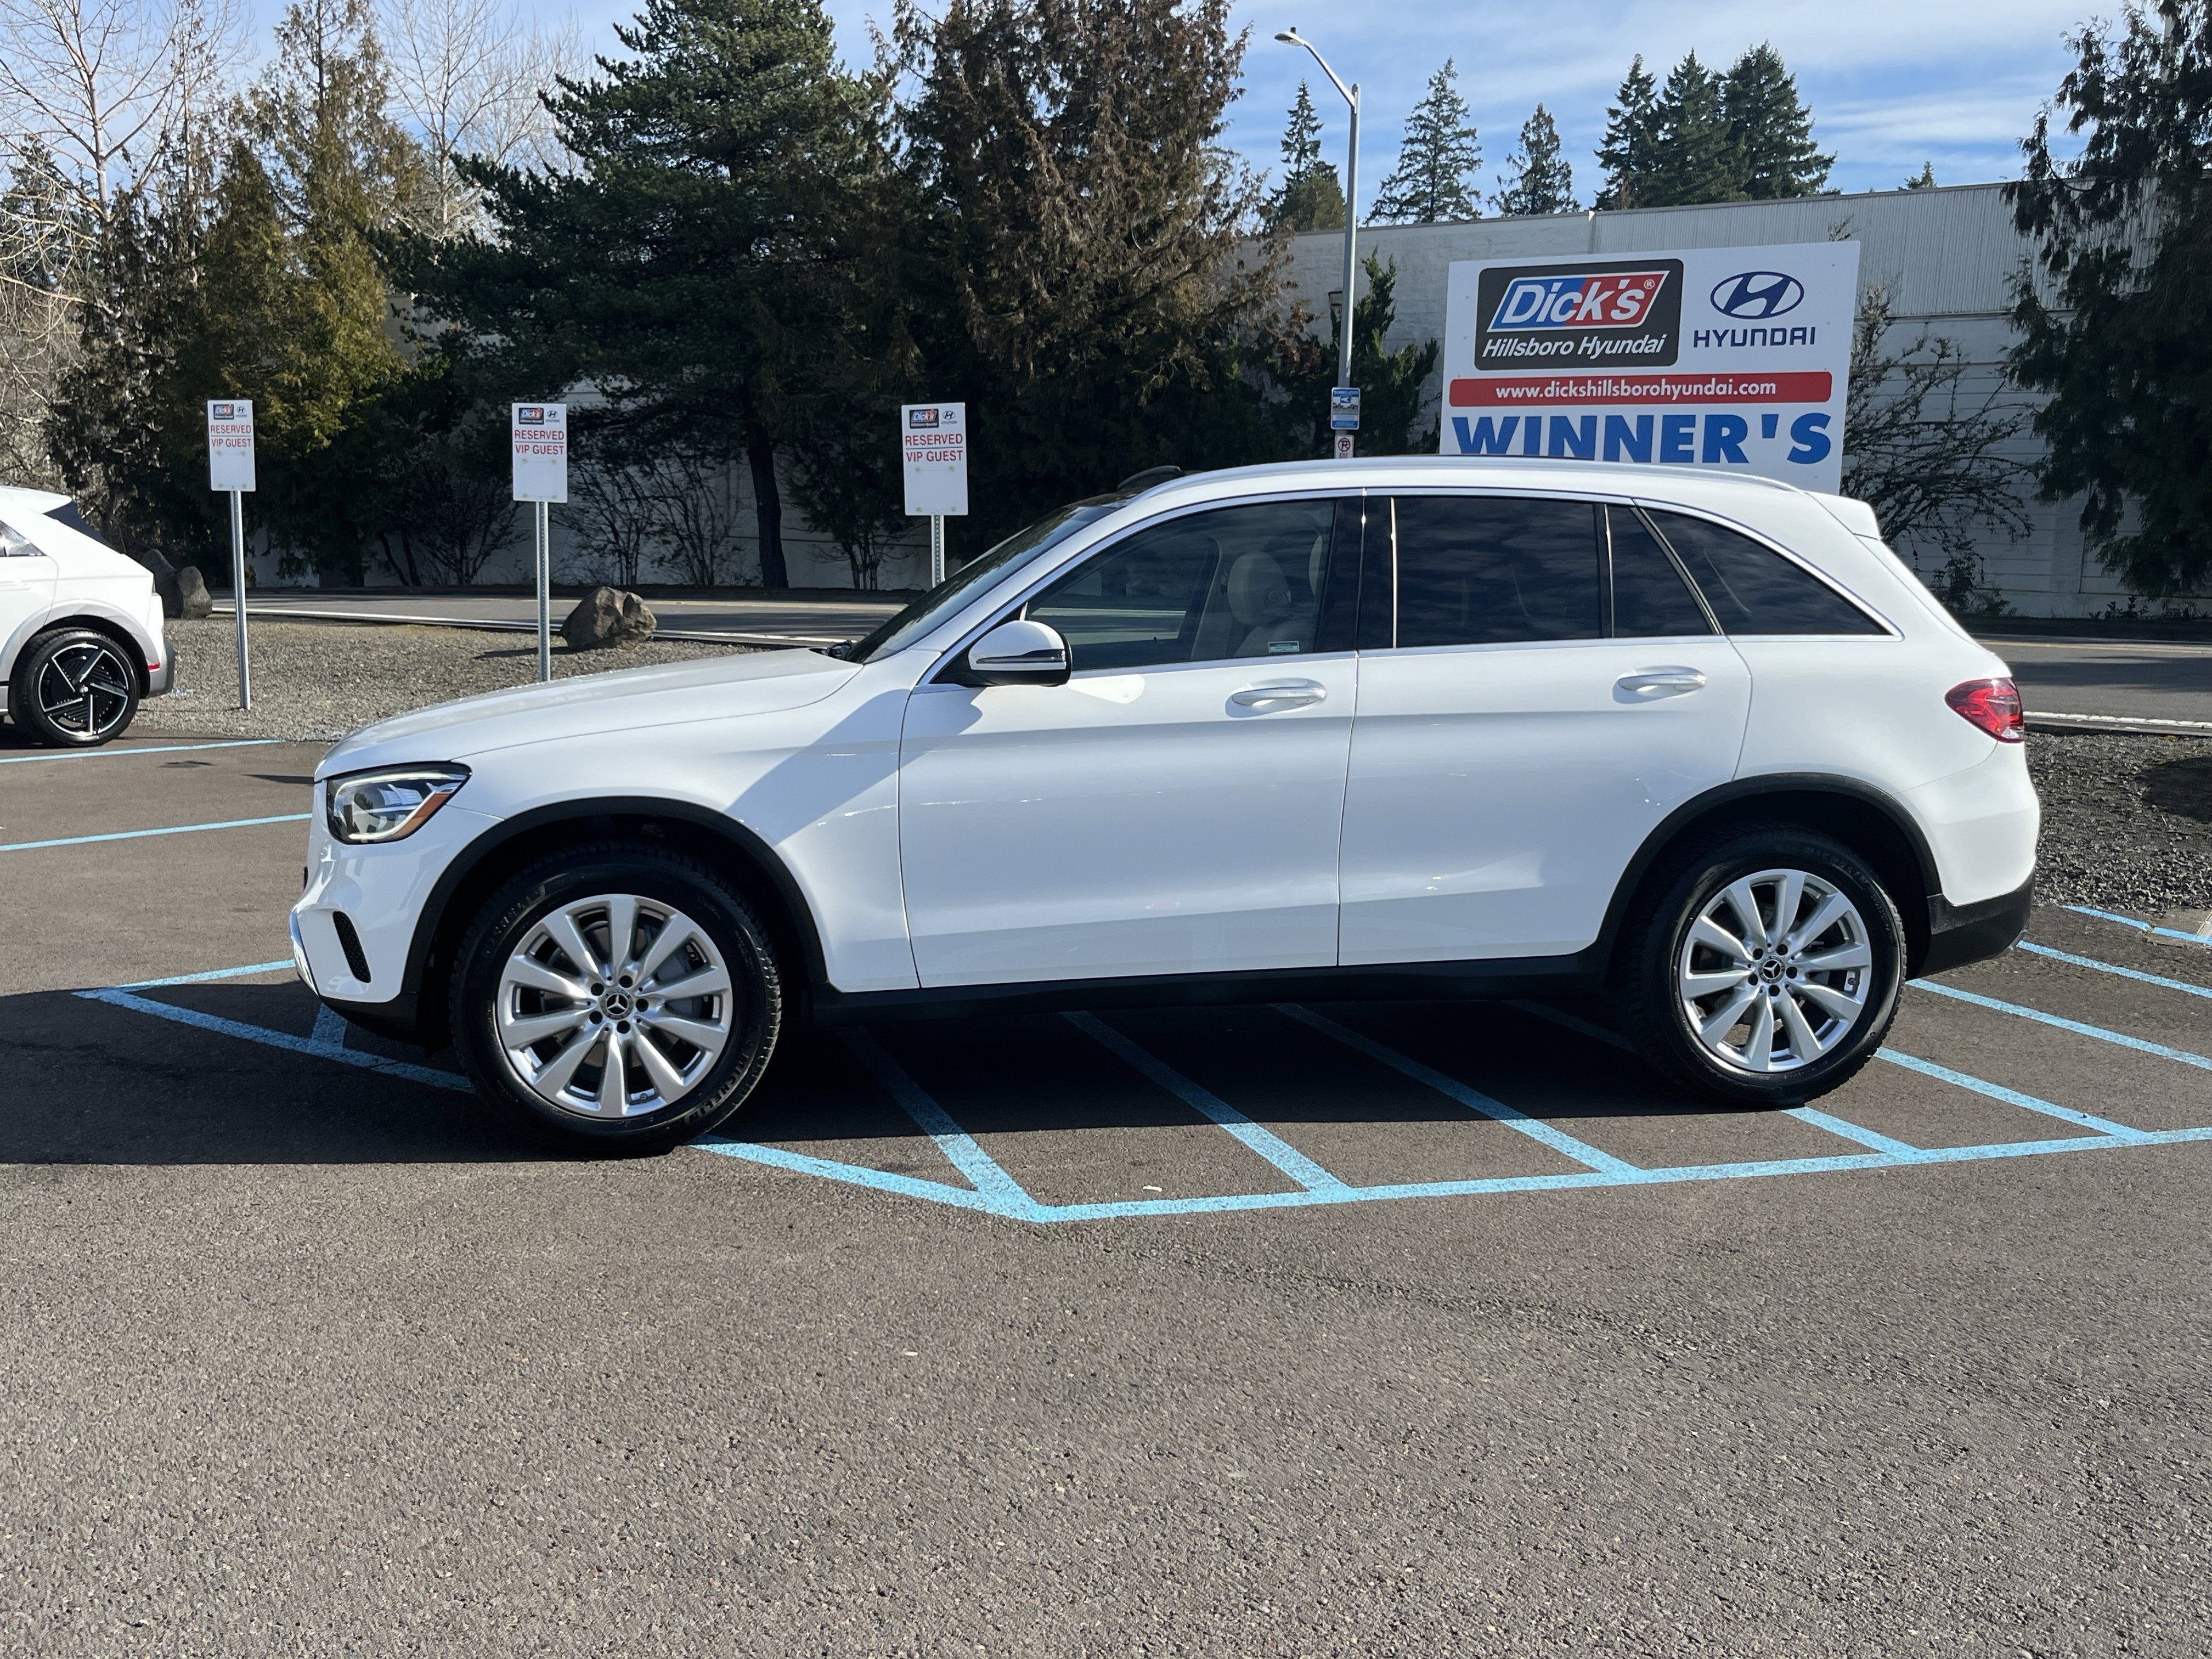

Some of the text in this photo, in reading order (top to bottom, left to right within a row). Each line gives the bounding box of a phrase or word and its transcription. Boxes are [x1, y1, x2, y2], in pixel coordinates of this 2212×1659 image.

[1693, 326, 1816, 348] HYUNDAI
[1482, 334, 1668, 360] Hillsboro Hyundai
[1496, 378, 1776, 400] www.dickshillsborohyundai.com
[210, 425, 251, 434] RESERVED
[515, 430, 565, 440] RESERVED
[211, 438, 251, 447] VIP GUEST
[905, 433, 963, 446] RESERVED
[1452, 413, 1831, 465] WINNER'S
[515, 444, 564, 455] VIP GUEST
[906, 450, 963, 462] VIP GUEST
